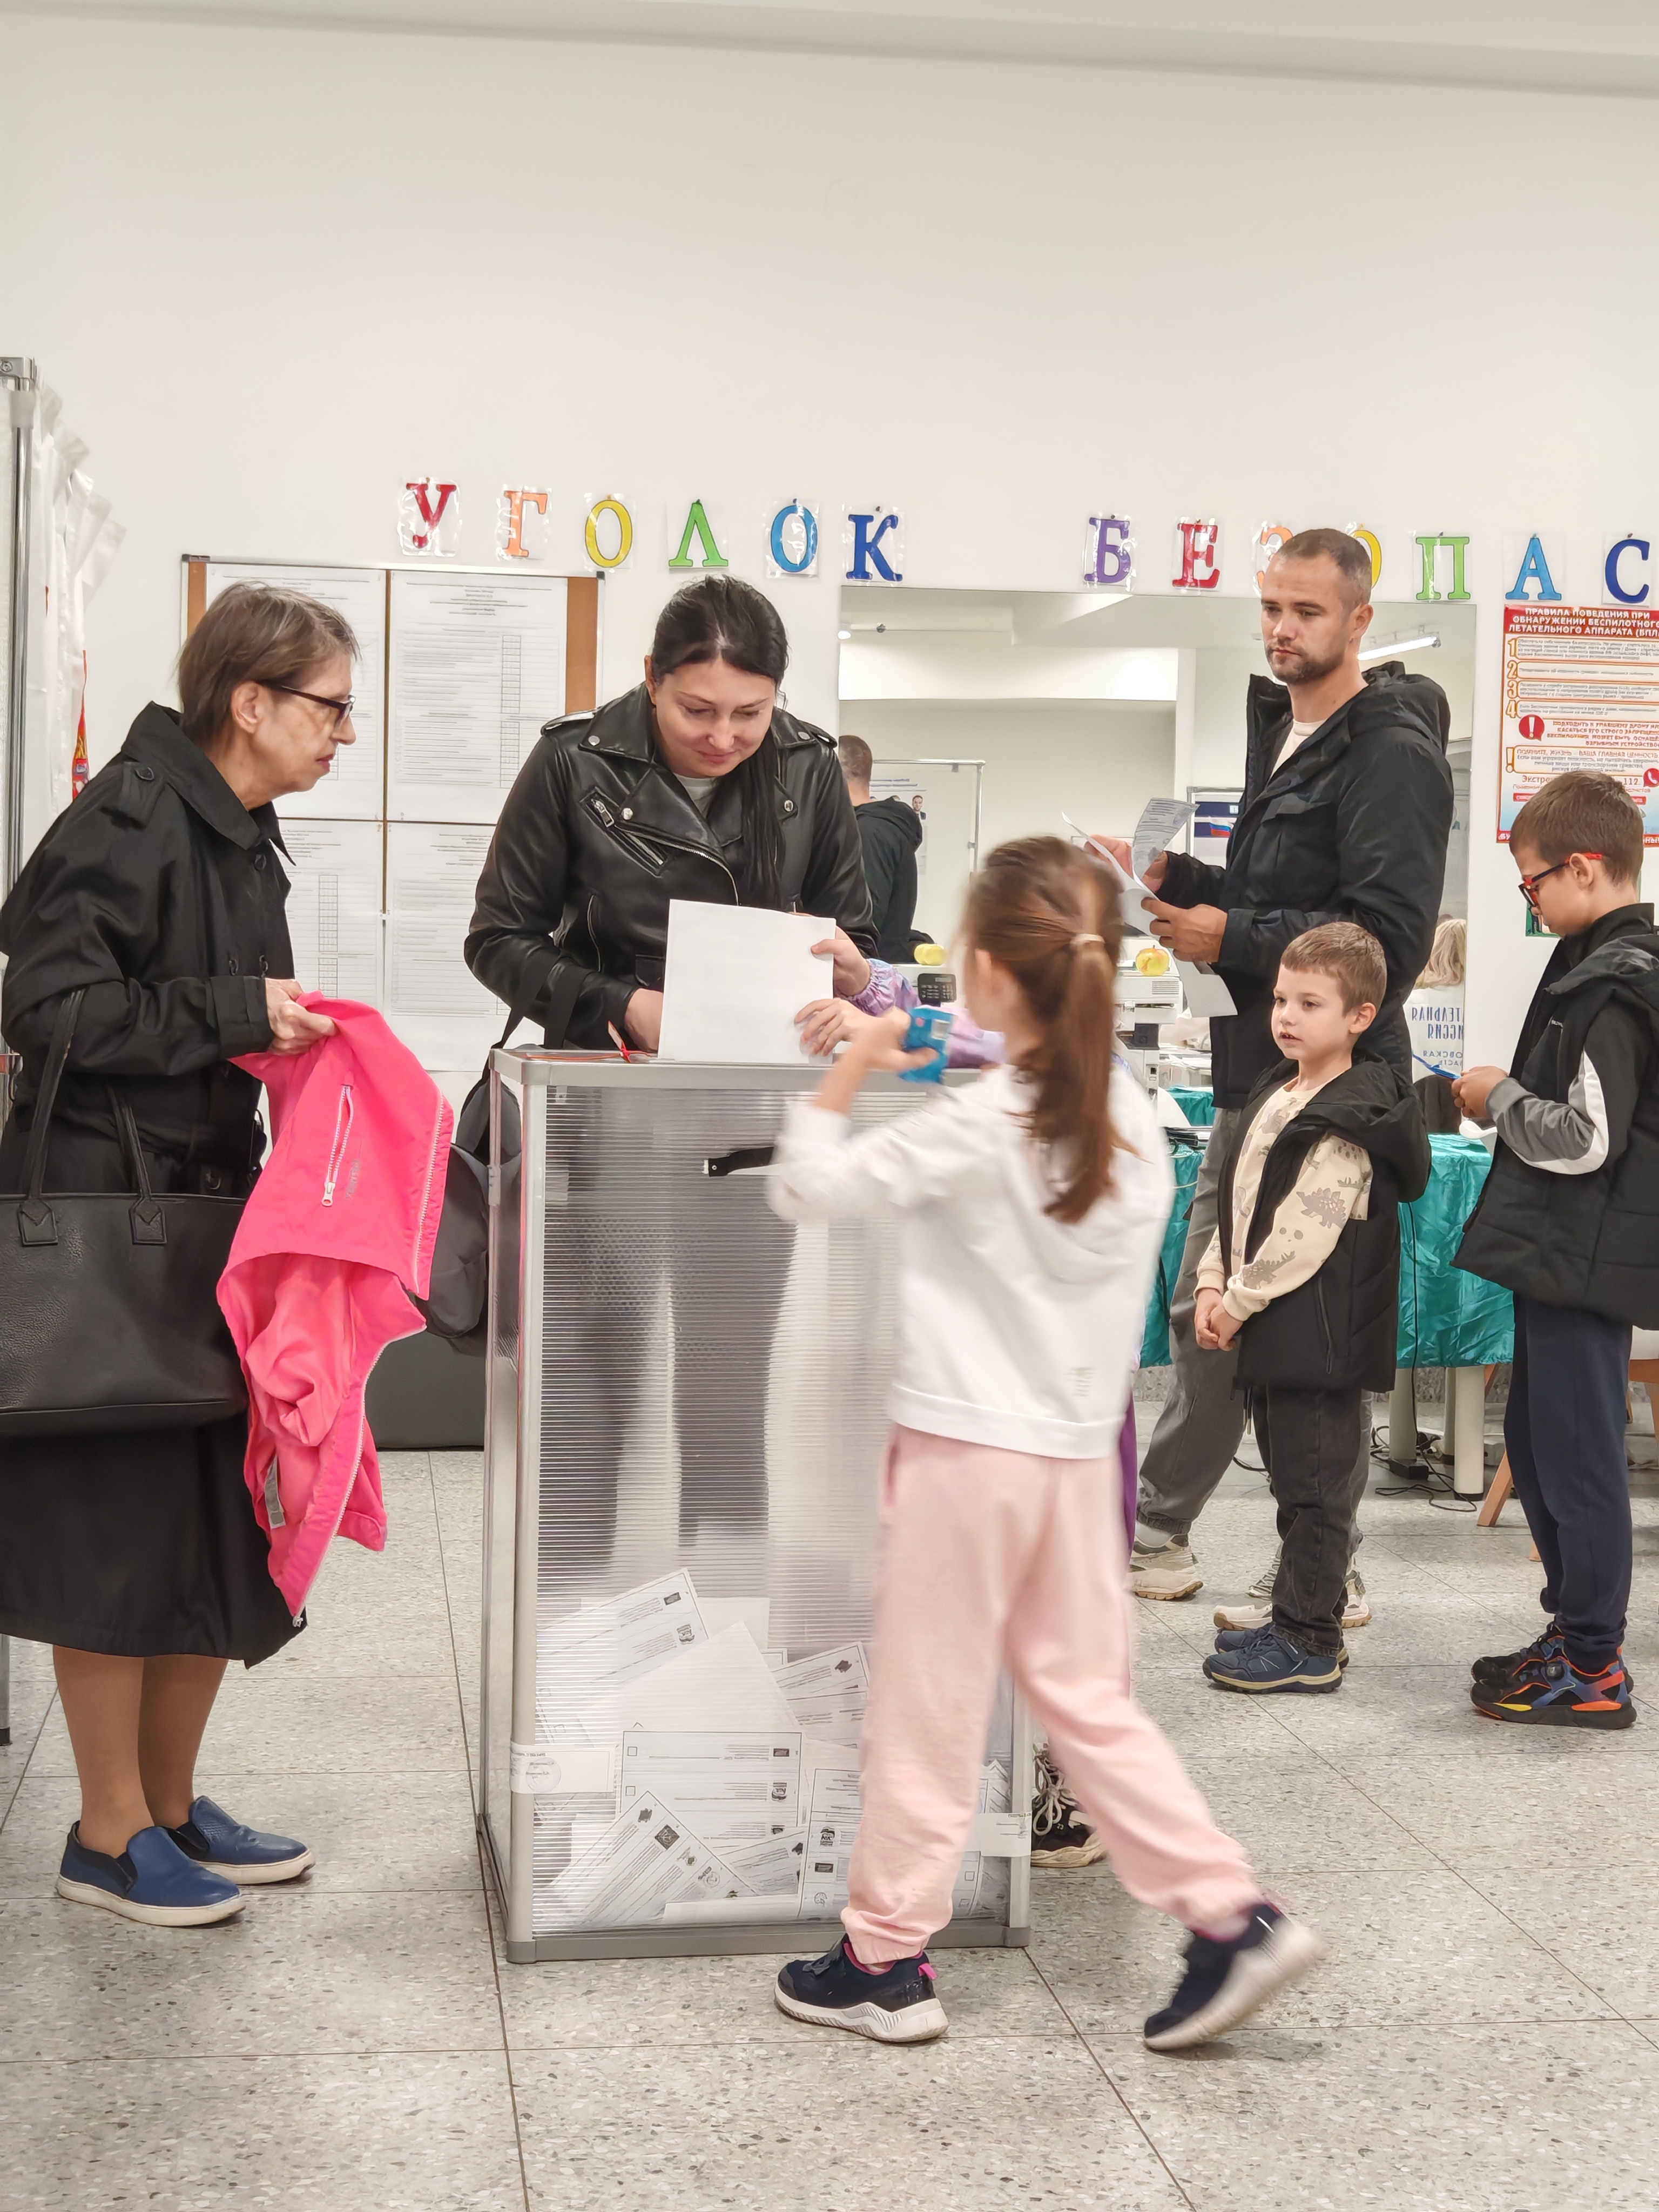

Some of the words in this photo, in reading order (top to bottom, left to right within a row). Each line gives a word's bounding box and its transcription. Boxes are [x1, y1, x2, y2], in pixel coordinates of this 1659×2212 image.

[1513, 616, 1586, 625] ОБНАРУЖЕНИИ
[1525, 608, 1570, 616] ПРАВИЛА
[1573, 609, 1629, 618] ПОВЕДЕНИЯ
[1509, 624, 1582, 633] ЛЕТАТЕЛЬНОГО
[1584, 627, 1633, 636] АППАРАТА
[1507, 638, 1517, 657] 1
[1507, 660, 1518, 679] 2
[1507, 680, 1518, 699] 3
[1506, 700, 1517, 718] 4
[1522, 775, 1550, 784] Экстре
